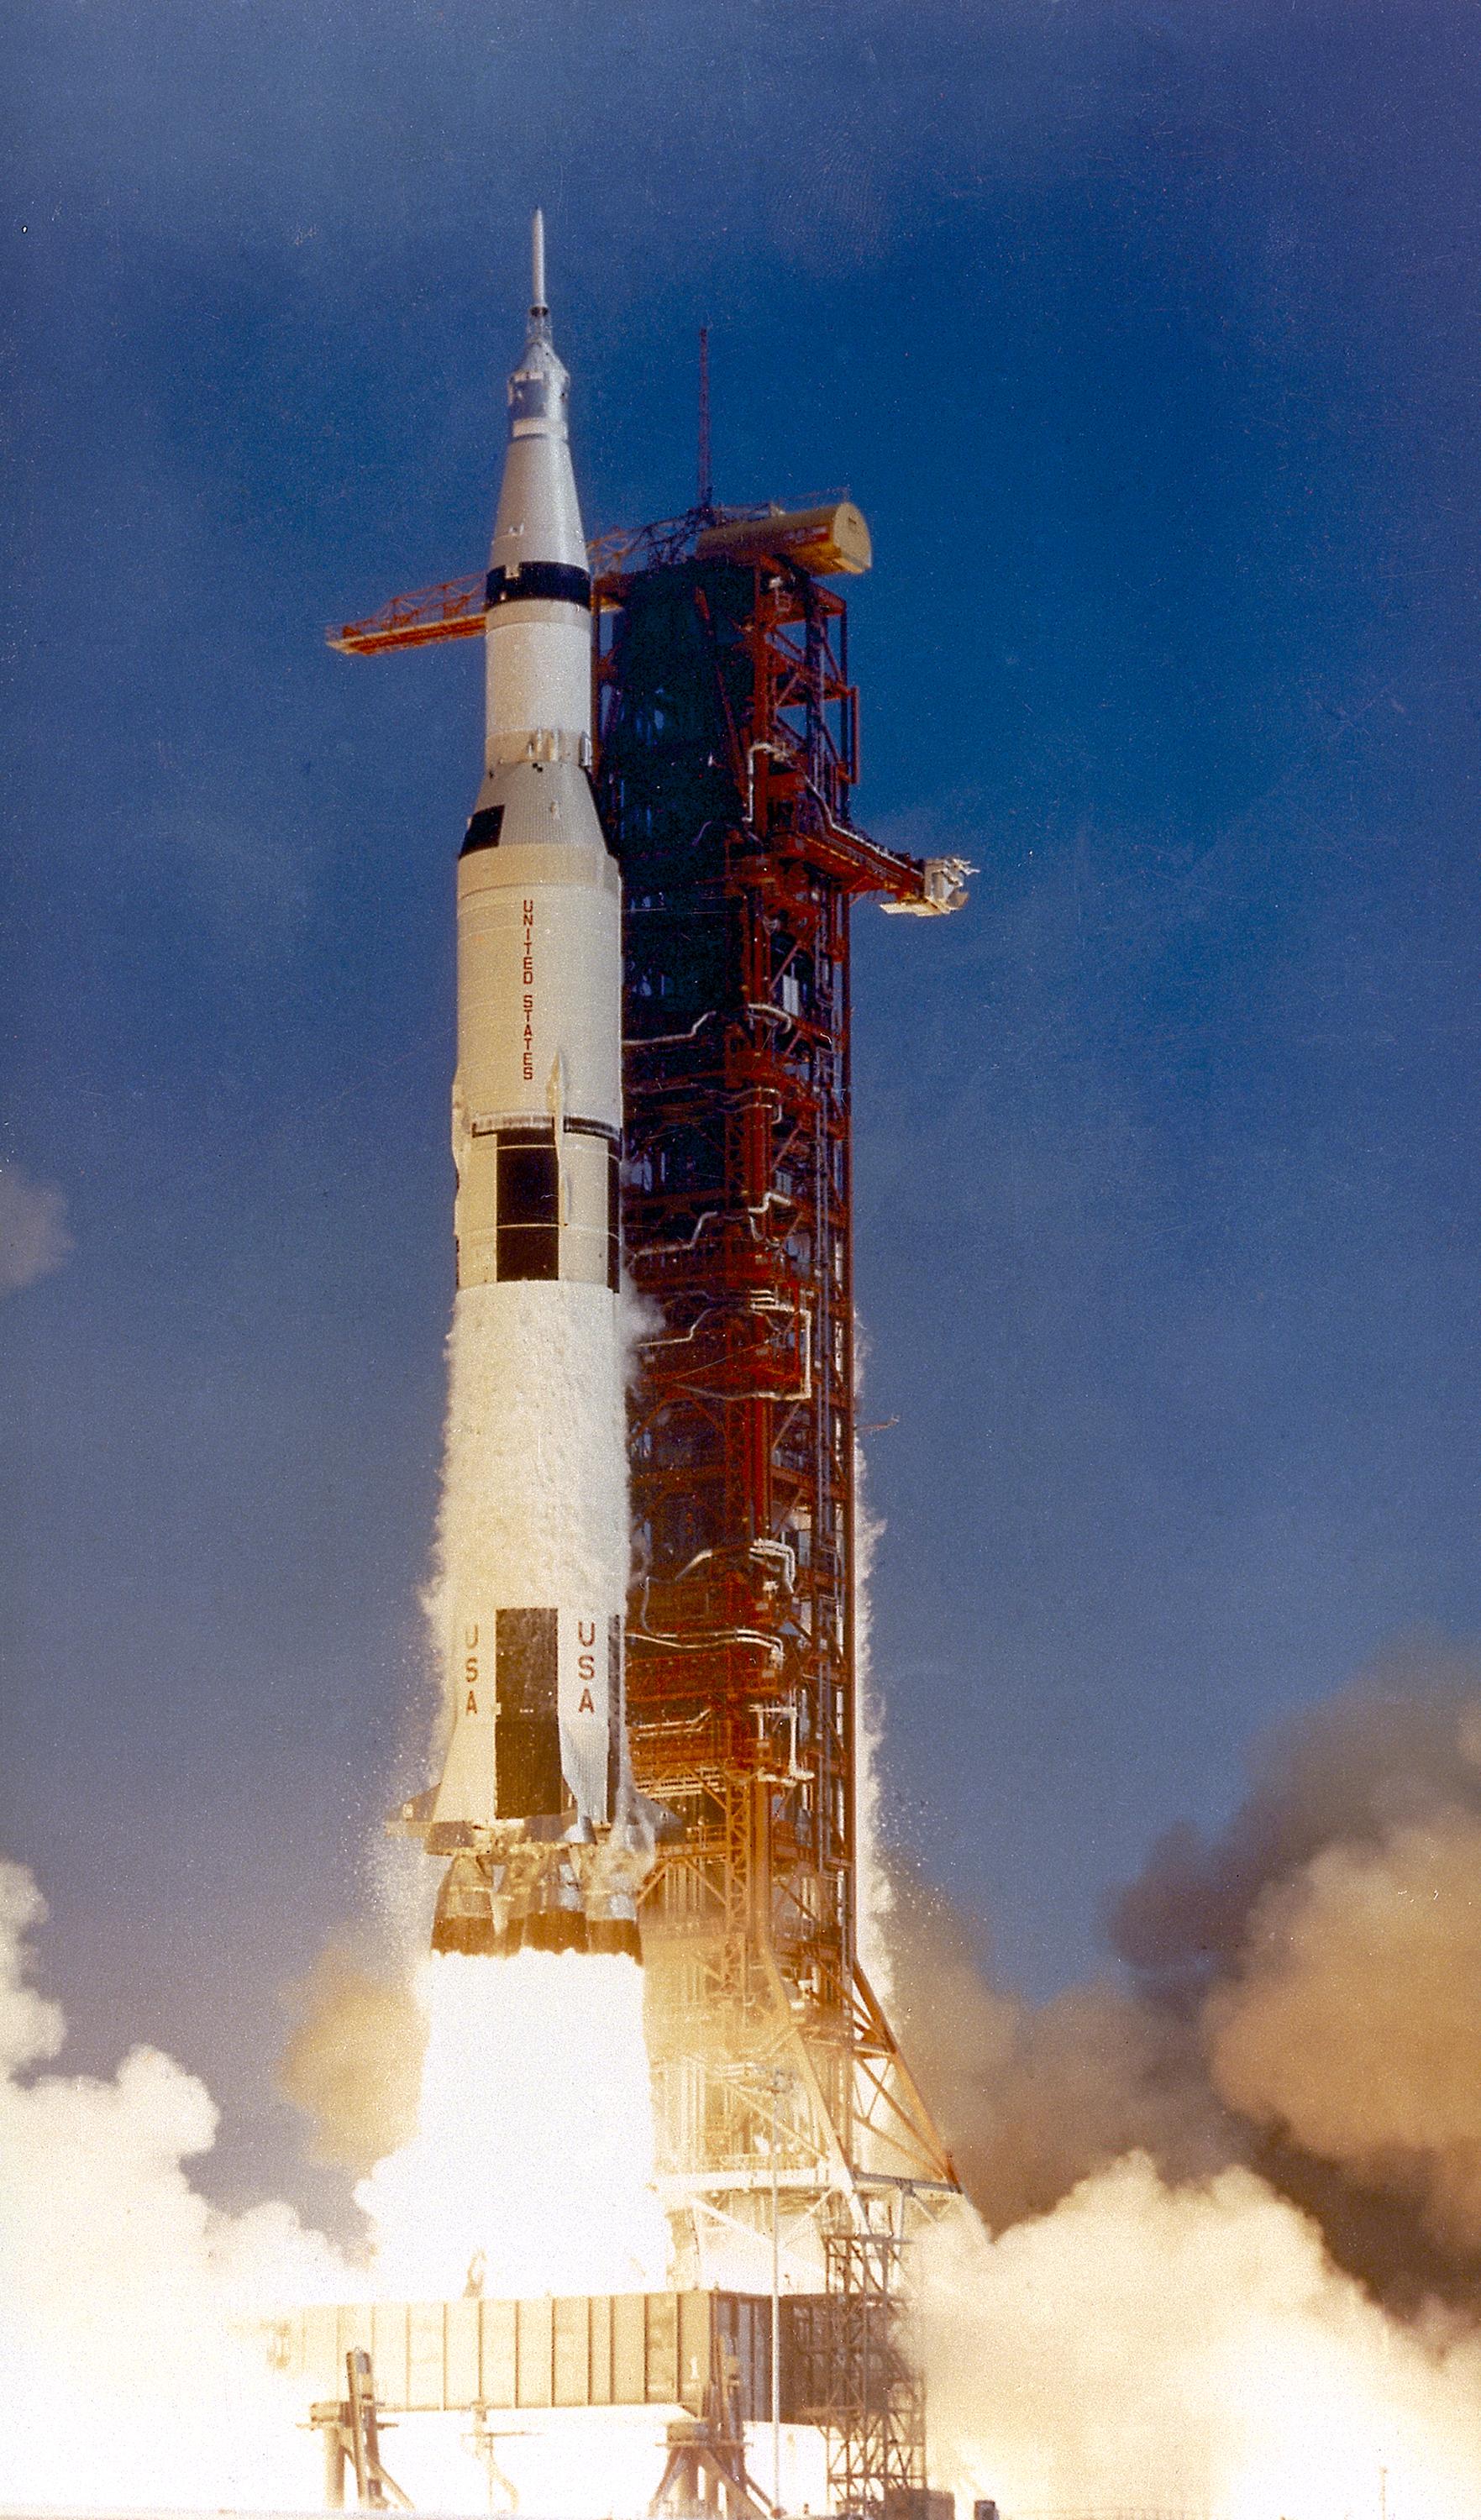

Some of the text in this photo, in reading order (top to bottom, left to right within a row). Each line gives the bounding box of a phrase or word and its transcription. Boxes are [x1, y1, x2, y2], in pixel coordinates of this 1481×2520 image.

[523, 900, 533, 1080] UNITED STATES
[465, 1625, 479, 1715] USA
[578, 1621, 595, 1714] USA
